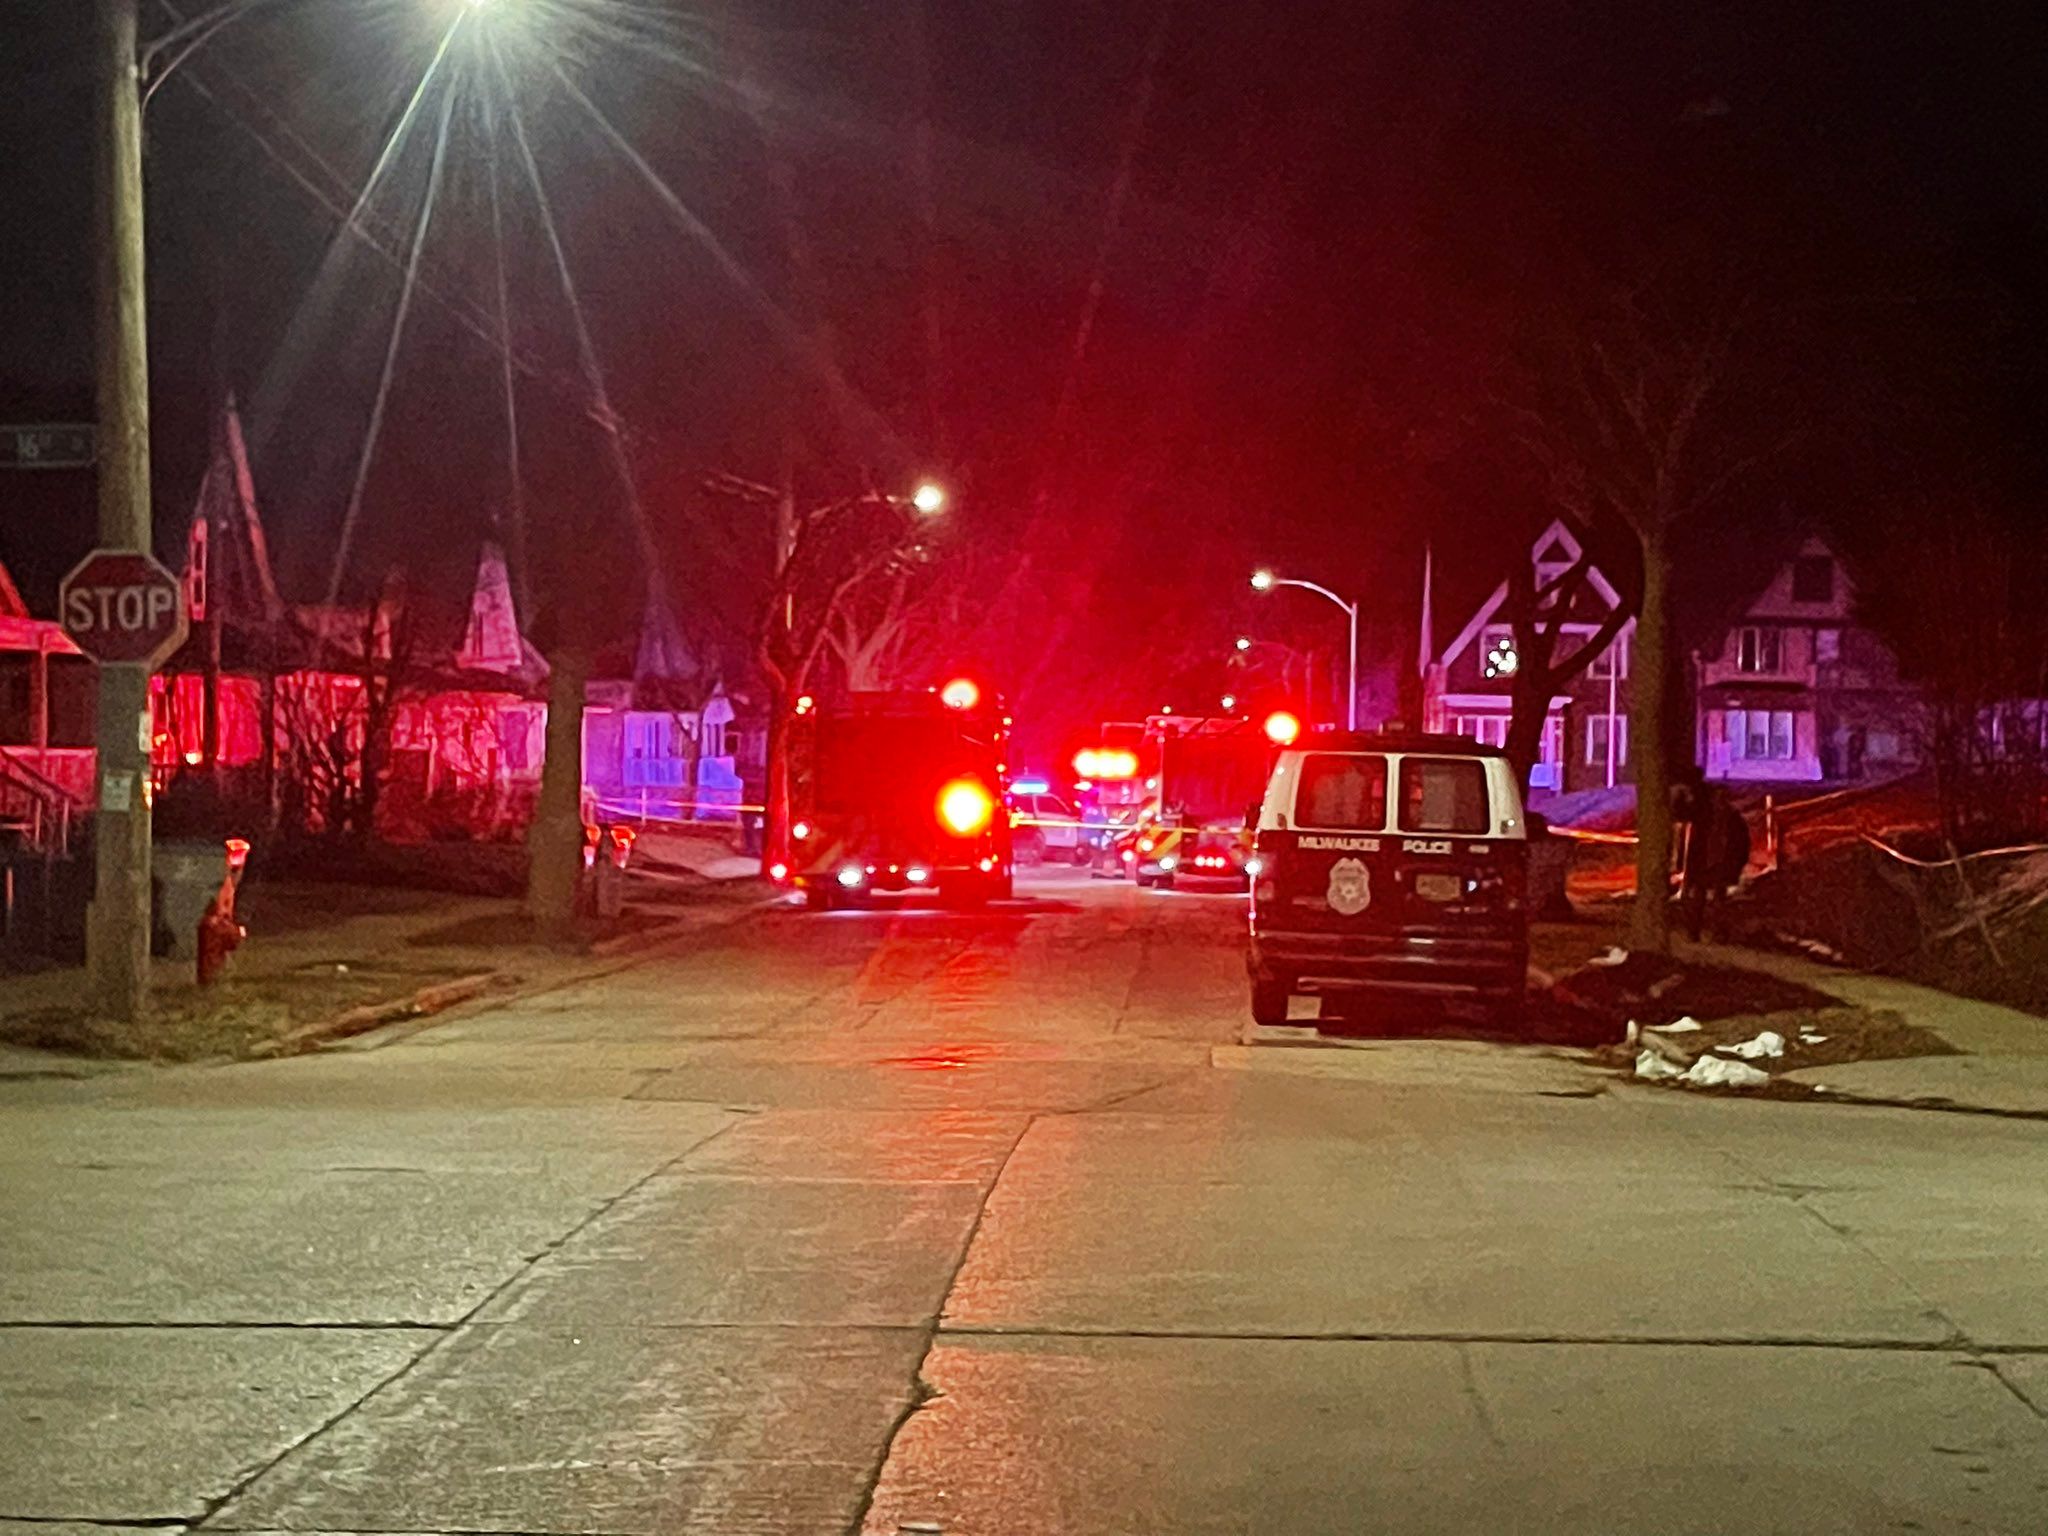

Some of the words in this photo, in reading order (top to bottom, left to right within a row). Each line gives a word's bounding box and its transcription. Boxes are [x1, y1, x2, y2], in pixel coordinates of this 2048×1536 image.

[69, 587, 172, 632] STOP
[1298, 837, 1380, 852] MILWAUKEE
[1402, 840, 1453, 854] POLICE
